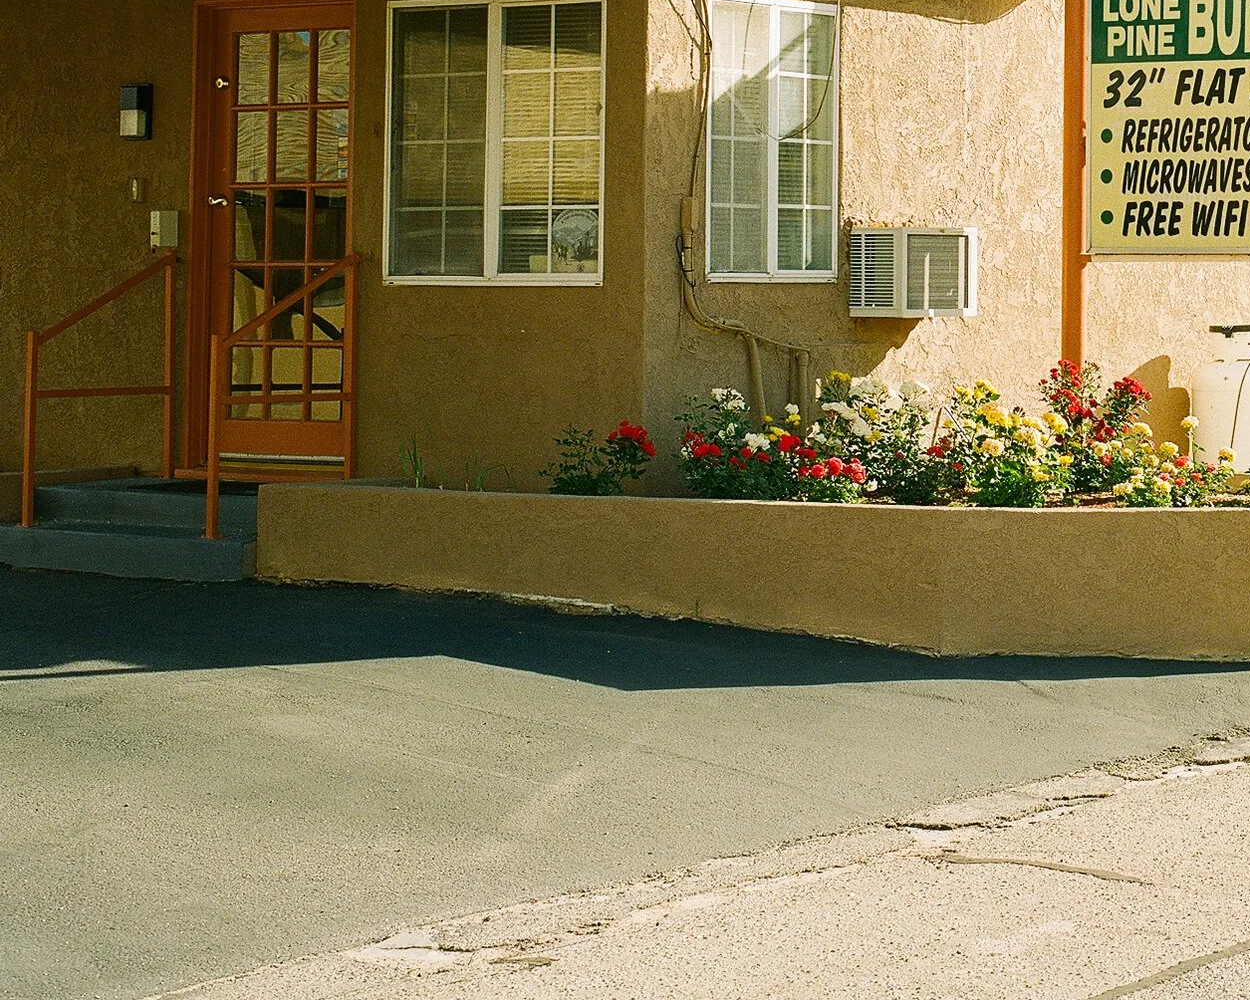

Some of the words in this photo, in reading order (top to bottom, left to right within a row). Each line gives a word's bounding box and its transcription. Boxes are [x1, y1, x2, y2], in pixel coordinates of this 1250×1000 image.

[1108, 24, 1175, 56] PINE
[1174, 68, 1245, 106] FLAT
[1122, 201, 1183, 236] FREE
[1192, 200, 1248, 236] WIFI
